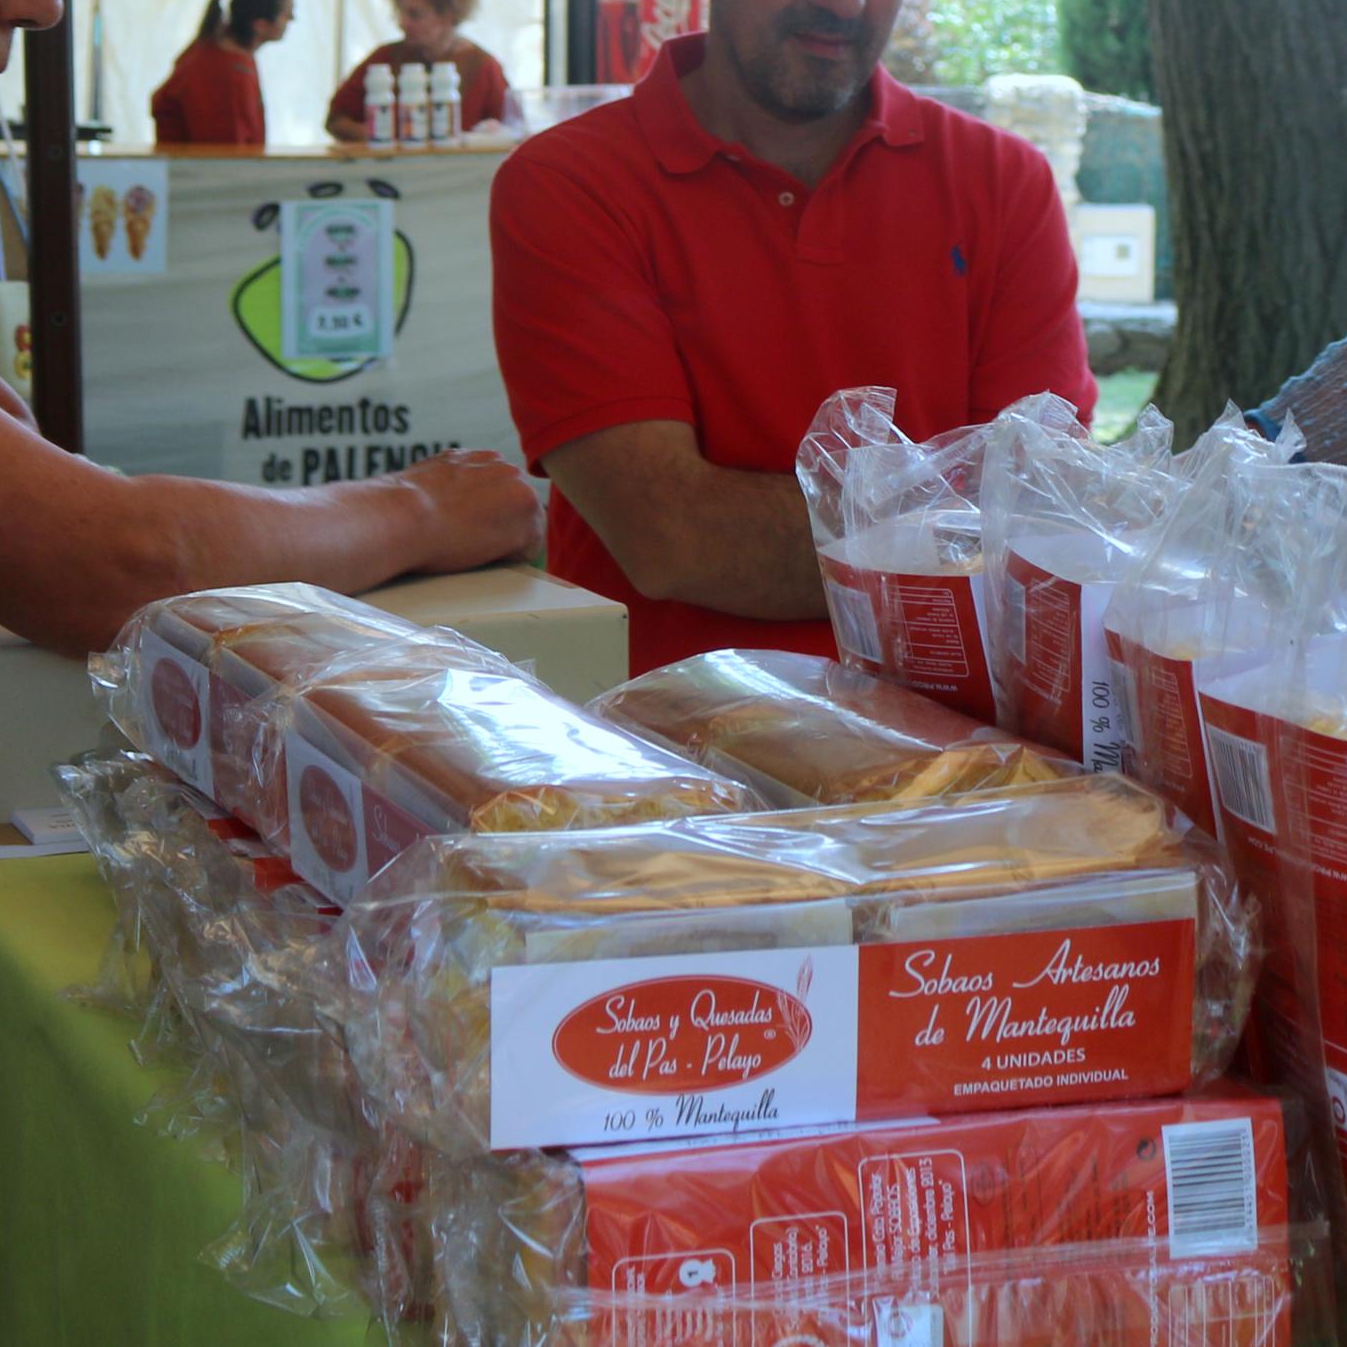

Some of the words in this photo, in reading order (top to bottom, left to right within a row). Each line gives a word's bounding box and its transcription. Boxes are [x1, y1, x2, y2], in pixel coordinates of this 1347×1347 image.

[242, 395, 410, 441] Alimentos
[261, 454, 293, 483] de
[1092, 681, 1111, 708] 100
[1089, 716, 1111, 734] %
[888, 948, 994, 998] Sobaos
[1012, 938, 1161, 988] Artesanos
[595, 994, 661, 1036] Sobaos
[669, 1013, 681, 1040] y
[690, 988, 773, 1030] Quesadas
[914, 1003, 945, 1047] de
[965, 983, 1136, 1046] Mantequilla
[608, 1043, 636, 1080] del
[641, 1036, 678, 1082] Pas
[701, 1032, 762, 1079] Pelayo
[981, 1056, 992, 1071] 4
[996, 1047, 1086, 1071] UNIDADES
[953, 1074, 1053, 1097] EMPAQUETADO
[1056, 1068, 1129, 1087] INDIVIDUAL
[603, 1108, 636, 1132] 100
[644, 1108, 665, 1133] %
[675, 1087, 780, 1130] Mantequilla
